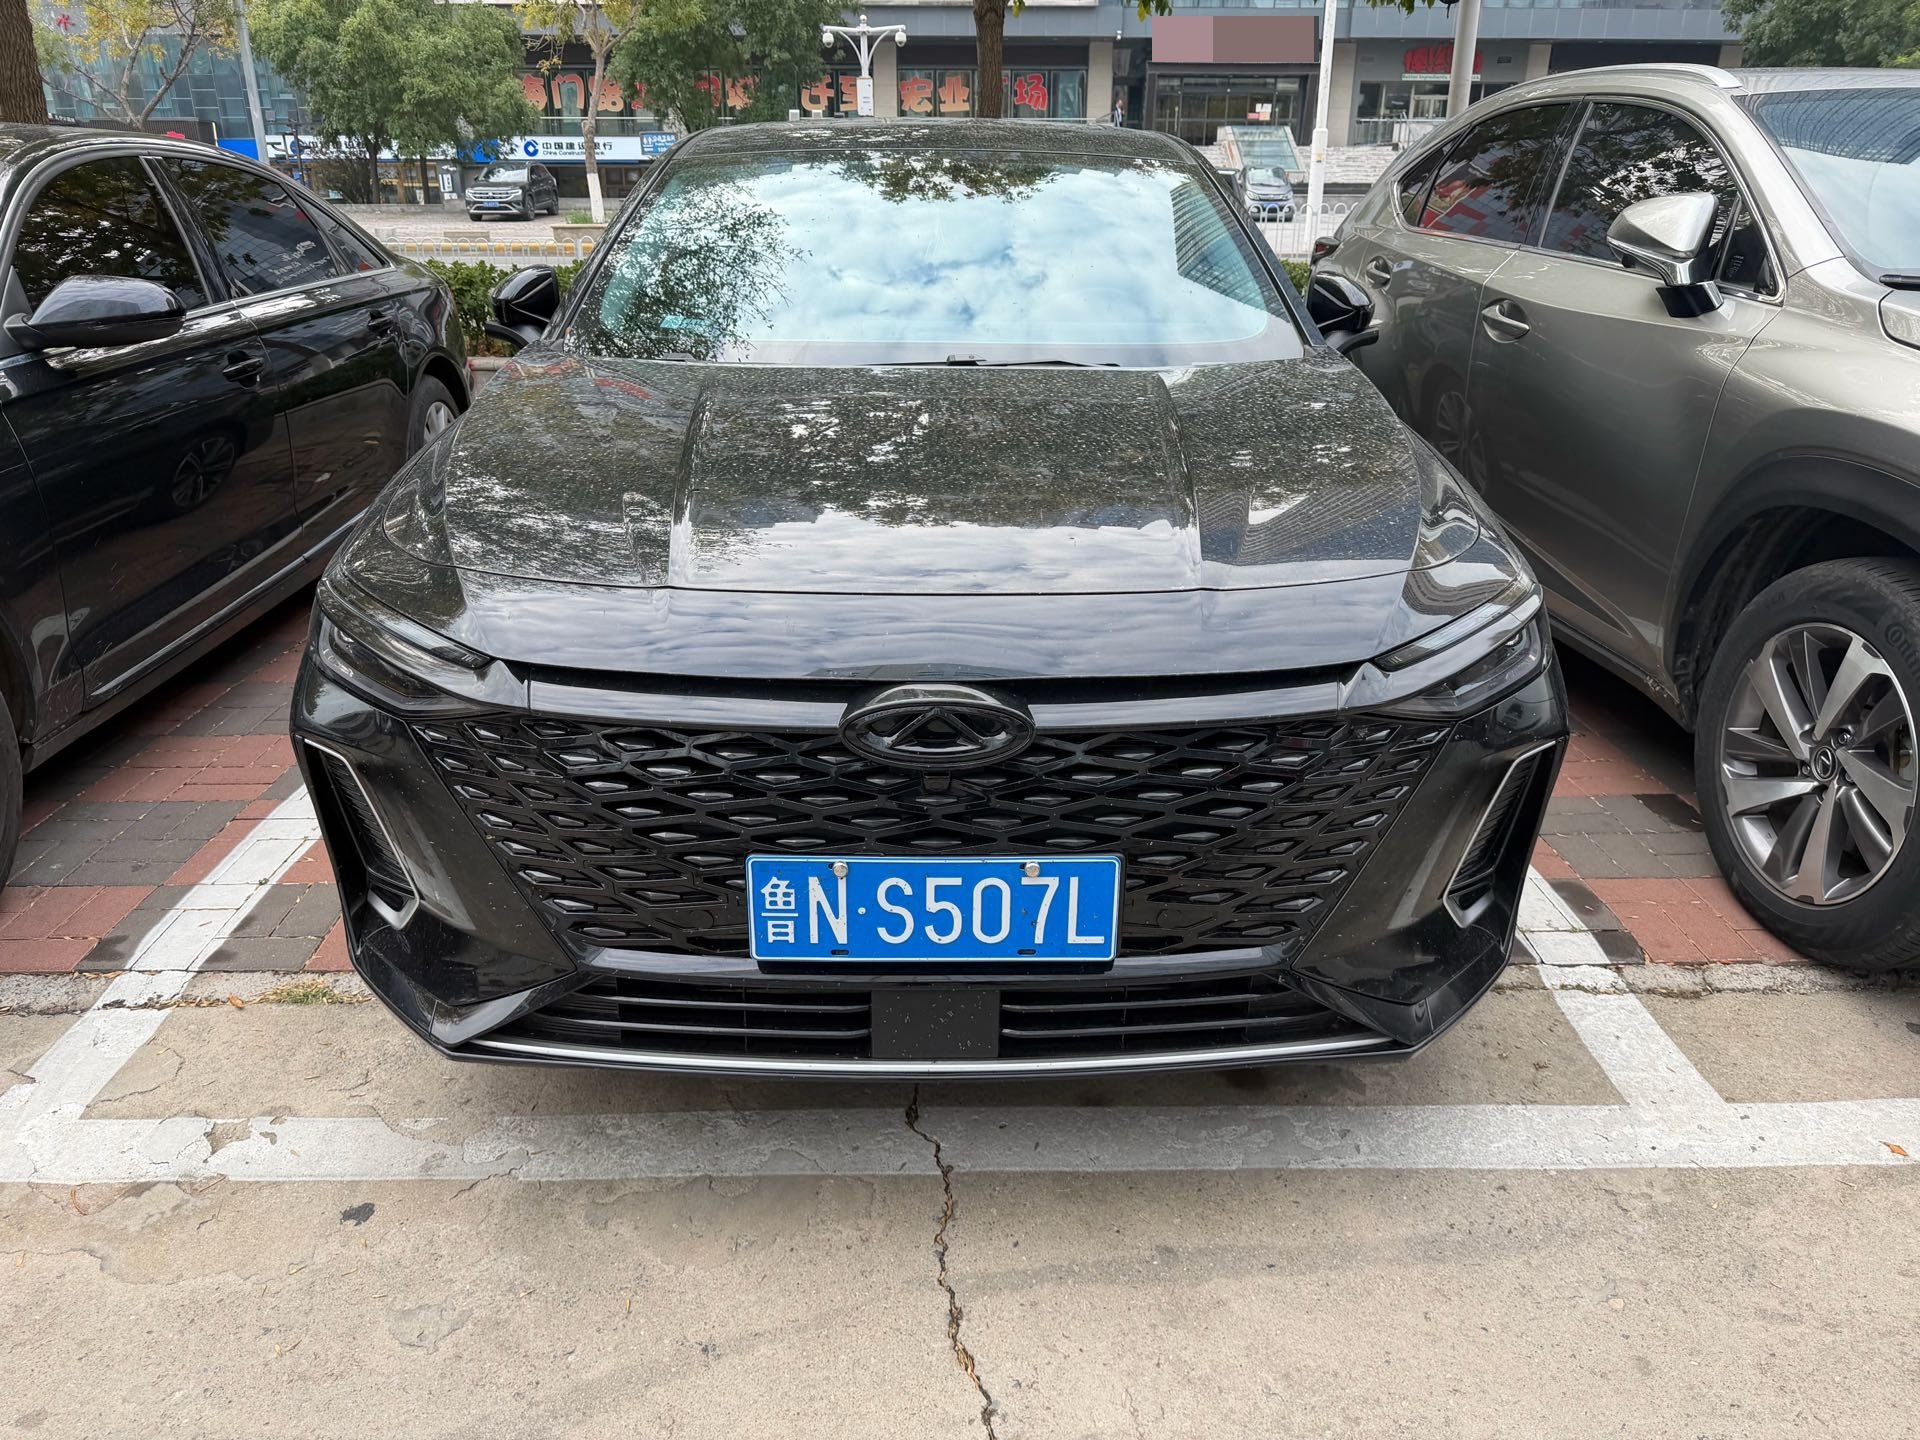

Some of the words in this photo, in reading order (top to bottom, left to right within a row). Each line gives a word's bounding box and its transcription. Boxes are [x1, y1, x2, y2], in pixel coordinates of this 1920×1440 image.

[542, 141, 613, 150] 中国建设银行
